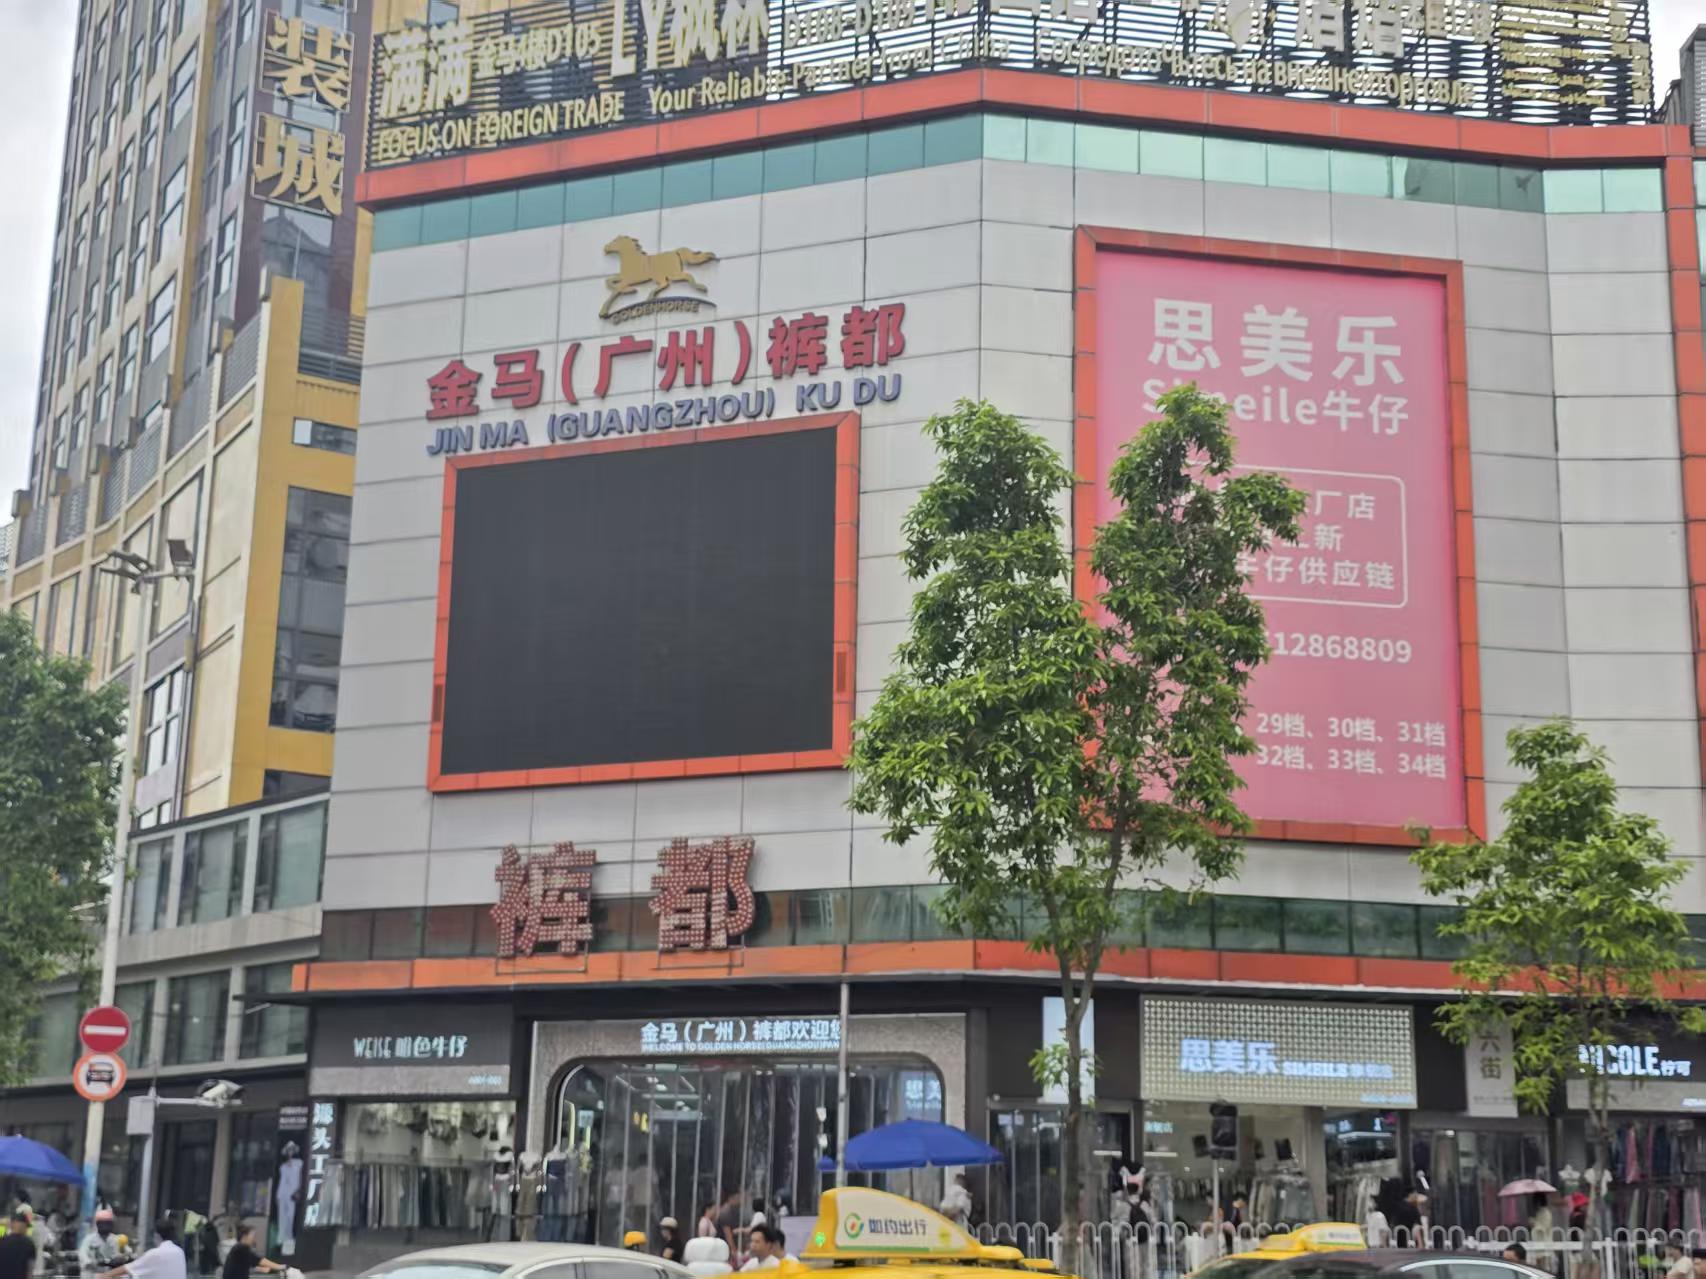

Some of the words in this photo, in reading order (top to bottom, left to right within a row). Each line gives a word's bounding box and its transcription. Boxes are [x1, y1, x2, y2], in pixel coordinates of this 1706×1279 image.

[648, 86, 697, 115] Your
[700, 66, 786, 106] Reliable
[792, 54, 873, 90] Partner
[880, 45, 934, 73] from
[940, 27, 1010, 62] China
[377, 119, 442, 161] FOCUS
[442, 117, 473, 149] ON
[475, 101, 558, 145] FOREIGN
[561, 91, 625, 131] TRADE
[426, 302, 907, 420] 金马（广州）裤都
[1147, 297, 1405, 387] 思美乐
[426, 424, 474, 457] JIN
[479, 417, 528, 449] MA
[546, 388, 775, 444] (GUANGZHOU)
[796, 382, 841, 413] KU
[853, 374, 902, 408] DU
[1142, 377, 1409, 435] Seile牛仔
[1264, 630, 1413, 663] 12868809
[489, 835, 756, 957] 裤都
[1180, 1037, 1279, 1074] 思美乐
[868, 1218, 928, 1236] 如约出行
